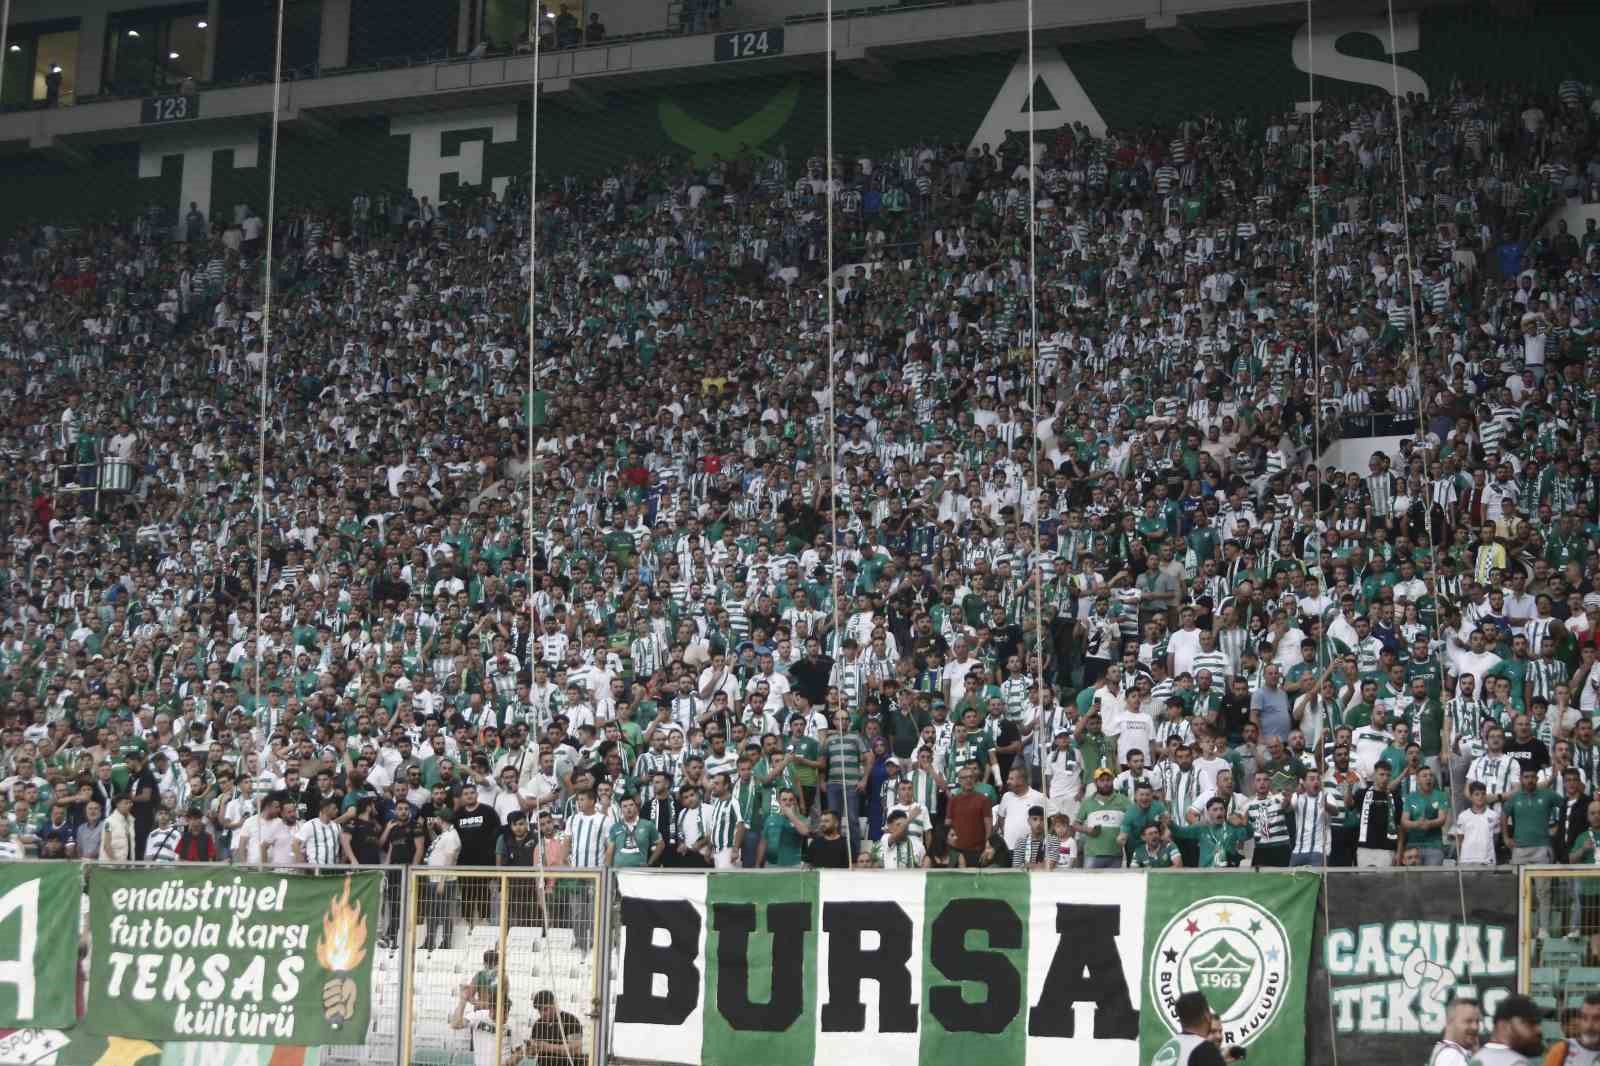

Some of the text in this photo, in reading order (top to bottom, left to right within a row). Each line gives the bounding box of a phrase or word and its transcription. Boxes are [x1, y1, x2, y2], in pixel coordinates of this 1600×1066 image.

[728, 32, 769, 57] 124
[152, 97, 187, 120] 123
[111, 876, 288, 919] endüstriyel
[110, 914, 221, 949] futbola
[1325, 920, 1517, 976] CASUAL
[107, 952, 305, 1002] TEKSAS
[614, 897, 1140, 1040] BURSA
[1200, 972, 1242, 988] 1963
[174, 1001, 296, 1037] kültürü
[1331, 980, 1510, 1034] TEKS
